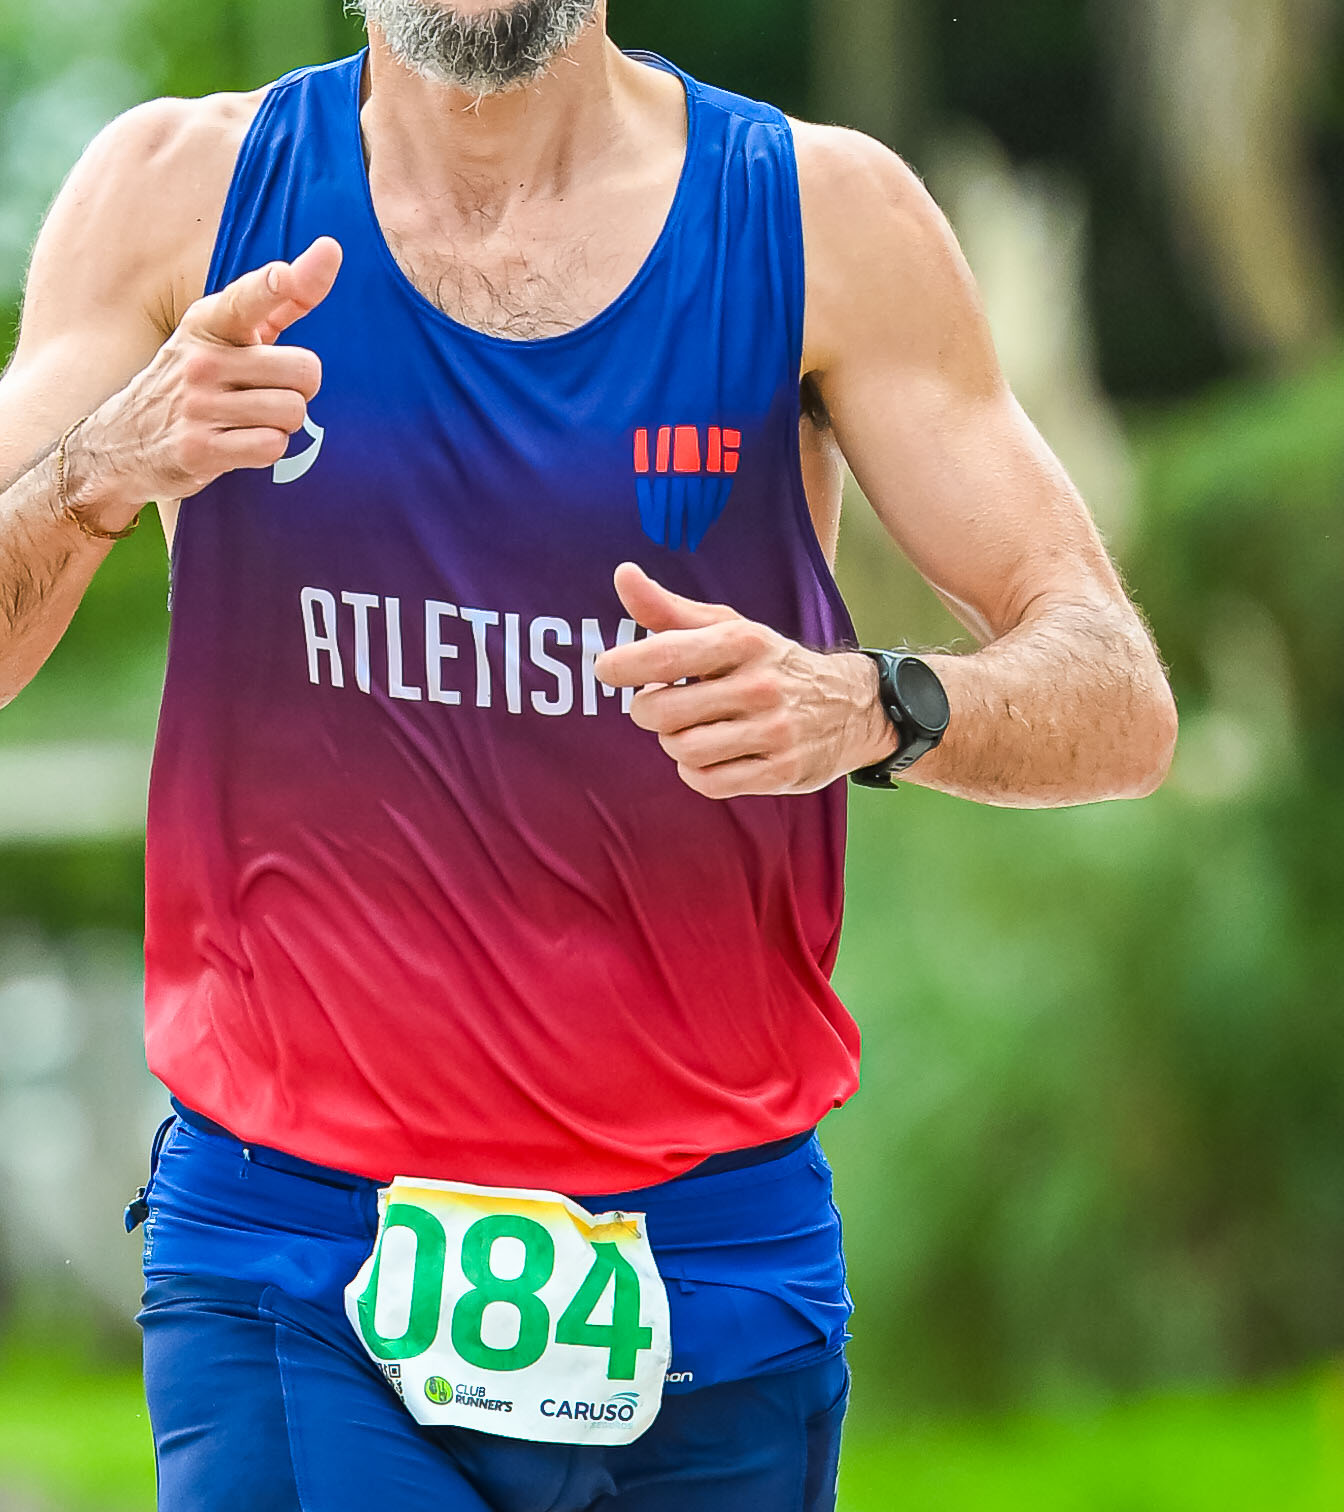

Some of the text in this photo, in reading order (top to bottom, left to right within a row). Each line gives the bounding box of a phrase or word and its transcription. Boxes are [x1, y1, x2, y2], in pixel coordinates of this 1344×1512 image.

[300, 586, 687, 716] ATLETISM
[358, 1203, 653, 1381] 084
[455, 1383, 486, 1397] CLUB
[455, 1394, 513, 1413] RUNNER'S
[539, 1398, 635, 1422] CARUSO
